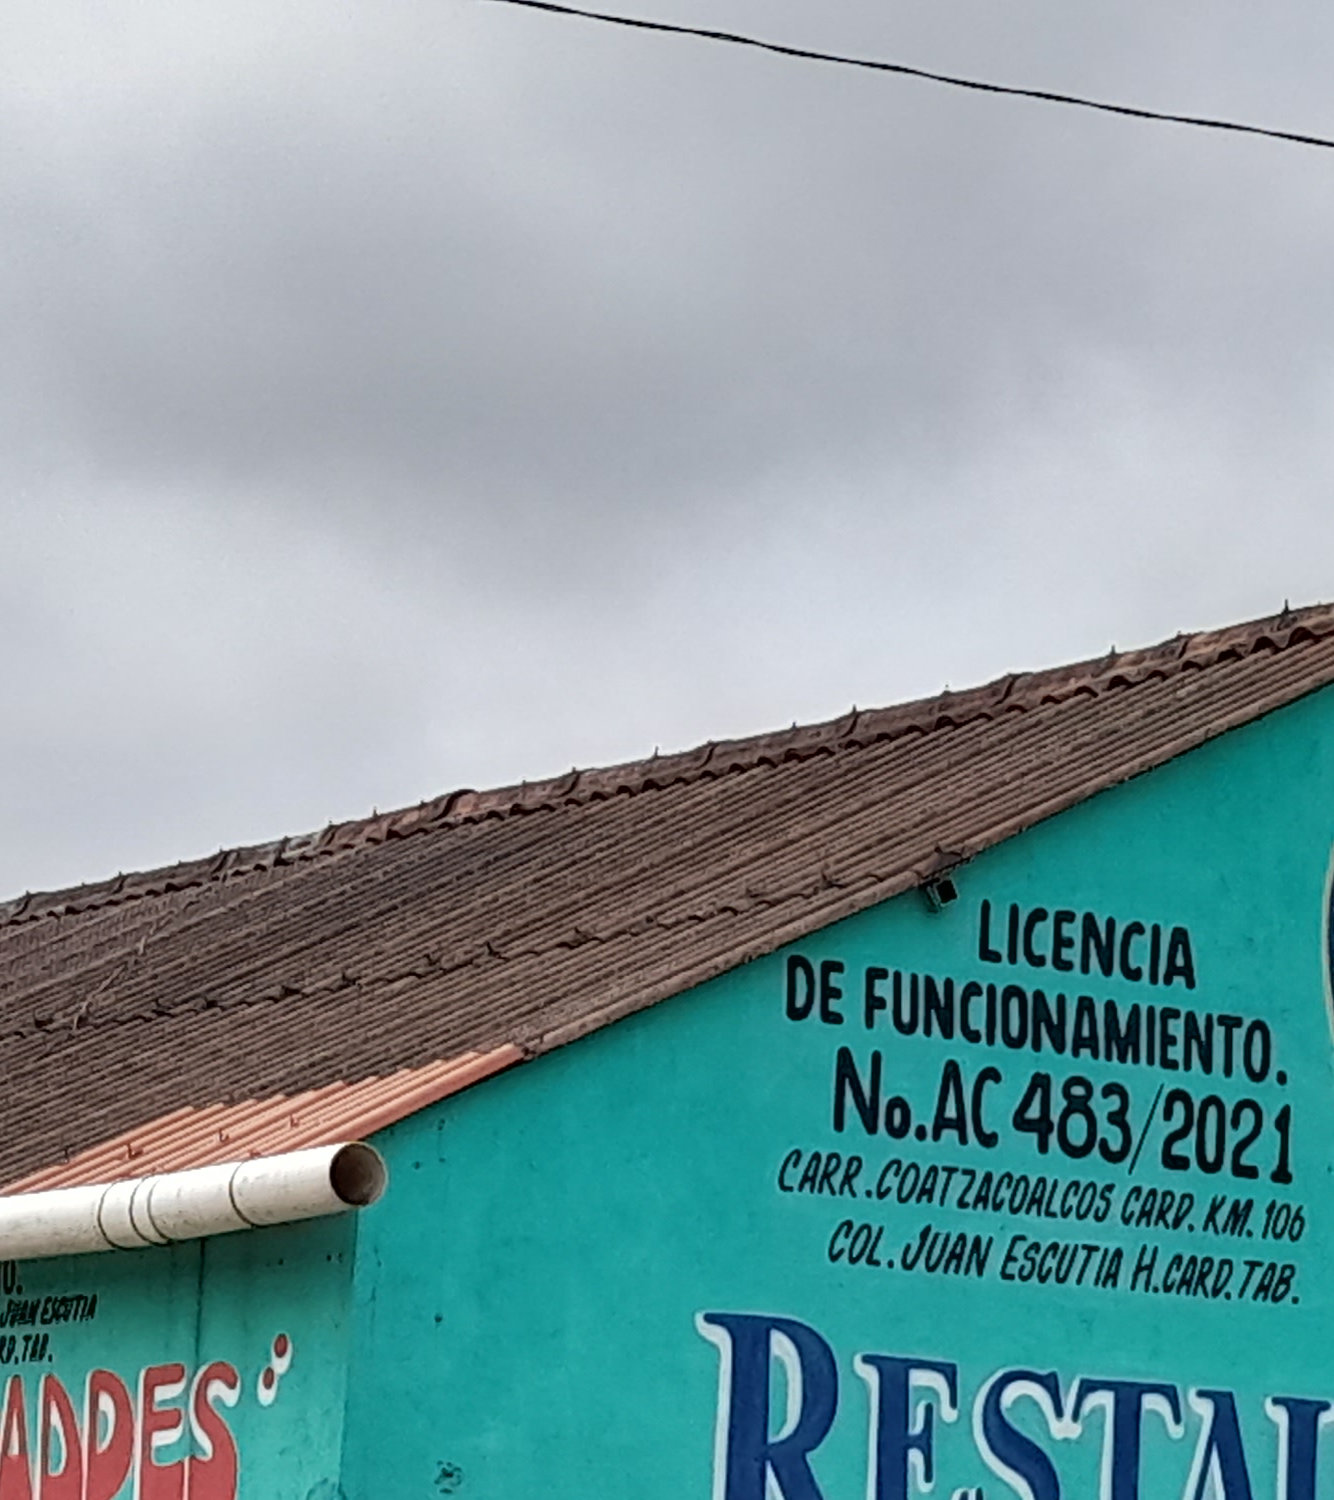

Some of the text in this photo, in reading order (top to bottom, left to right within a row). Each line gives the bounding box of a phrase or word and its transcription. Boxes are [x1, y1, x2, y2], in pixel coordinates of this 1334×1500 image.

[977, 898, 1197, 990] LICENCIA
[785, 954, 1289, 1087] DE FUNCIONAMIENTO.
[1011, 1068, 1295, 1186] 483/2021
[900, 1223, 993, 1279] JUAN
[998, 1233, 1122, 1292] ESCUTIA
[1119, 1184, 1197, 1234] CARD.
[1201, 1193, 1256, 1240] KM.
[1262, 1203, 1306, 1243] 106
